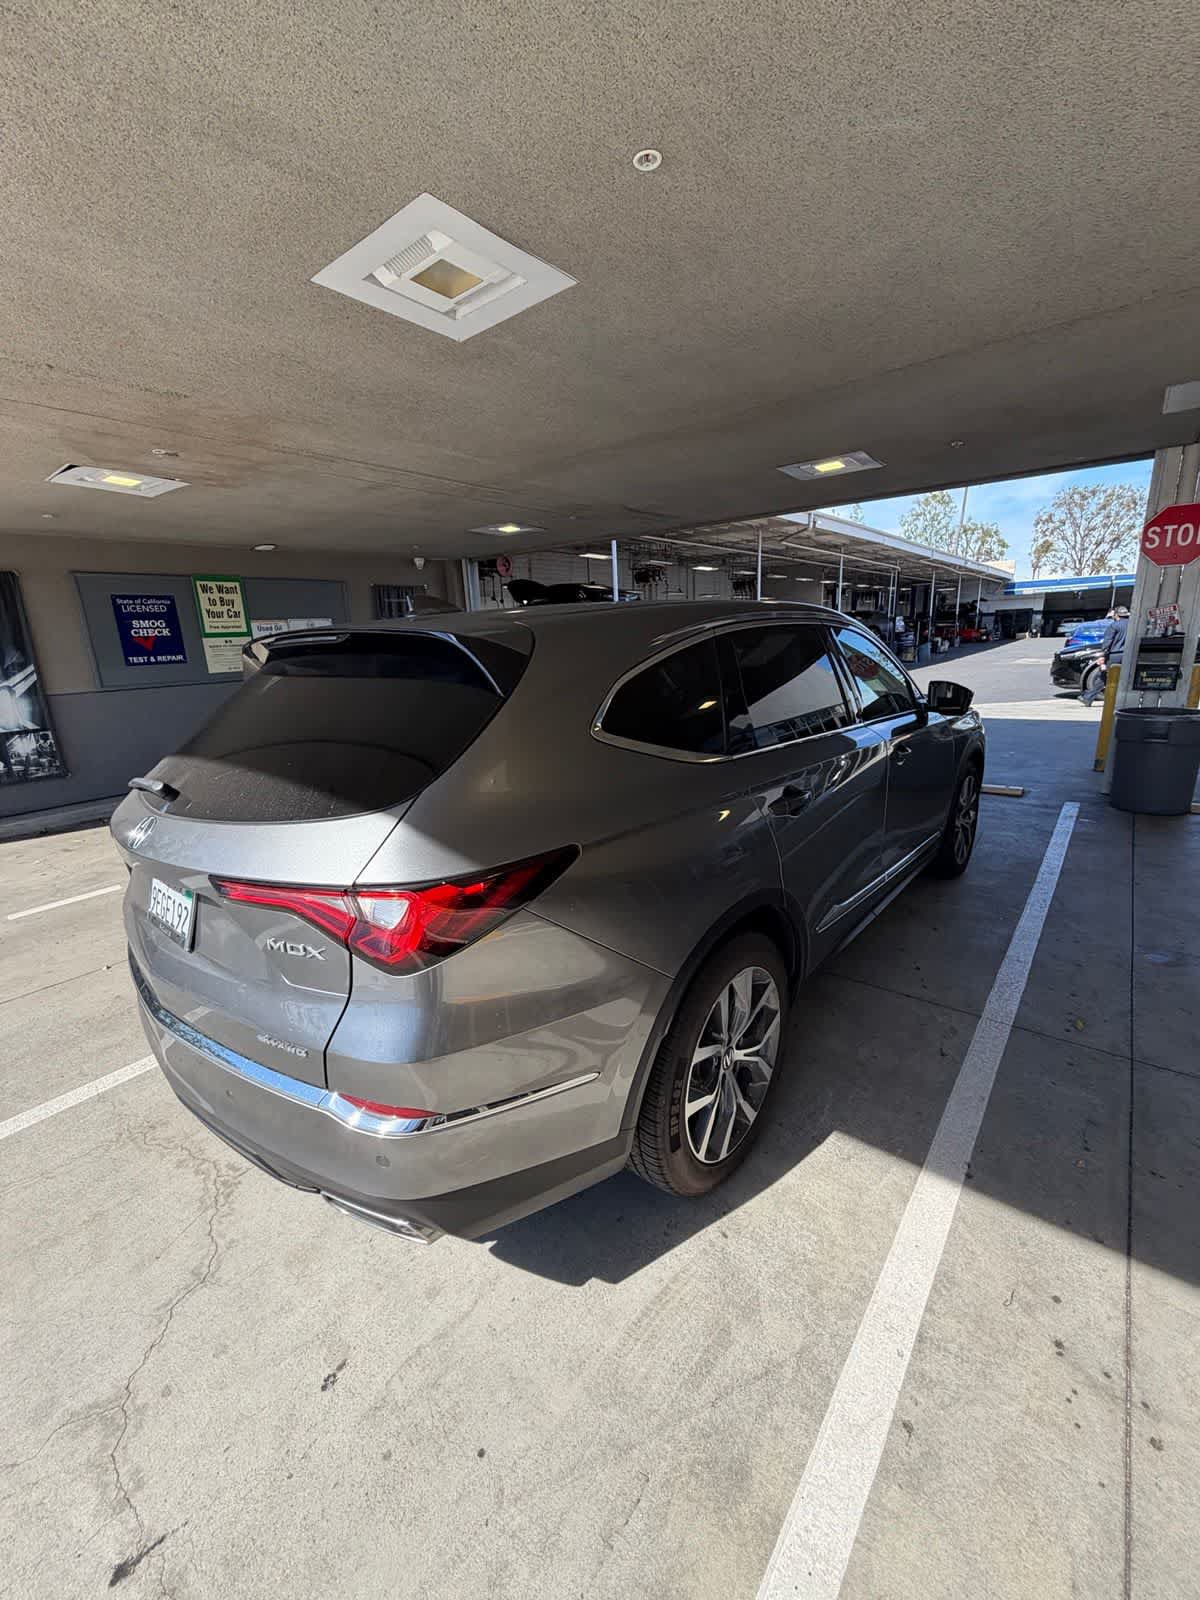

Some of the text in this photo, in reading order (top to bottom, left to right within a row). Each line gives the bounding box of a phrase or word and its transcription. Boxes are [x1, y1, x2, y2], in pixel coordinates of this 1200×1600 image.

[200, 583, 238, 595] We Want
[208, 597, 235, 608] to Buy
[121, 605, 167, 613] LICENSED
[206, 608, 241, 619] Your Car
[132, 620, 166, 628] SMOG
[131, 629, 171, 637] CHECK
[151, 886, 189, 937] 9EGE192
[266, 938, 326, 960] MDX
